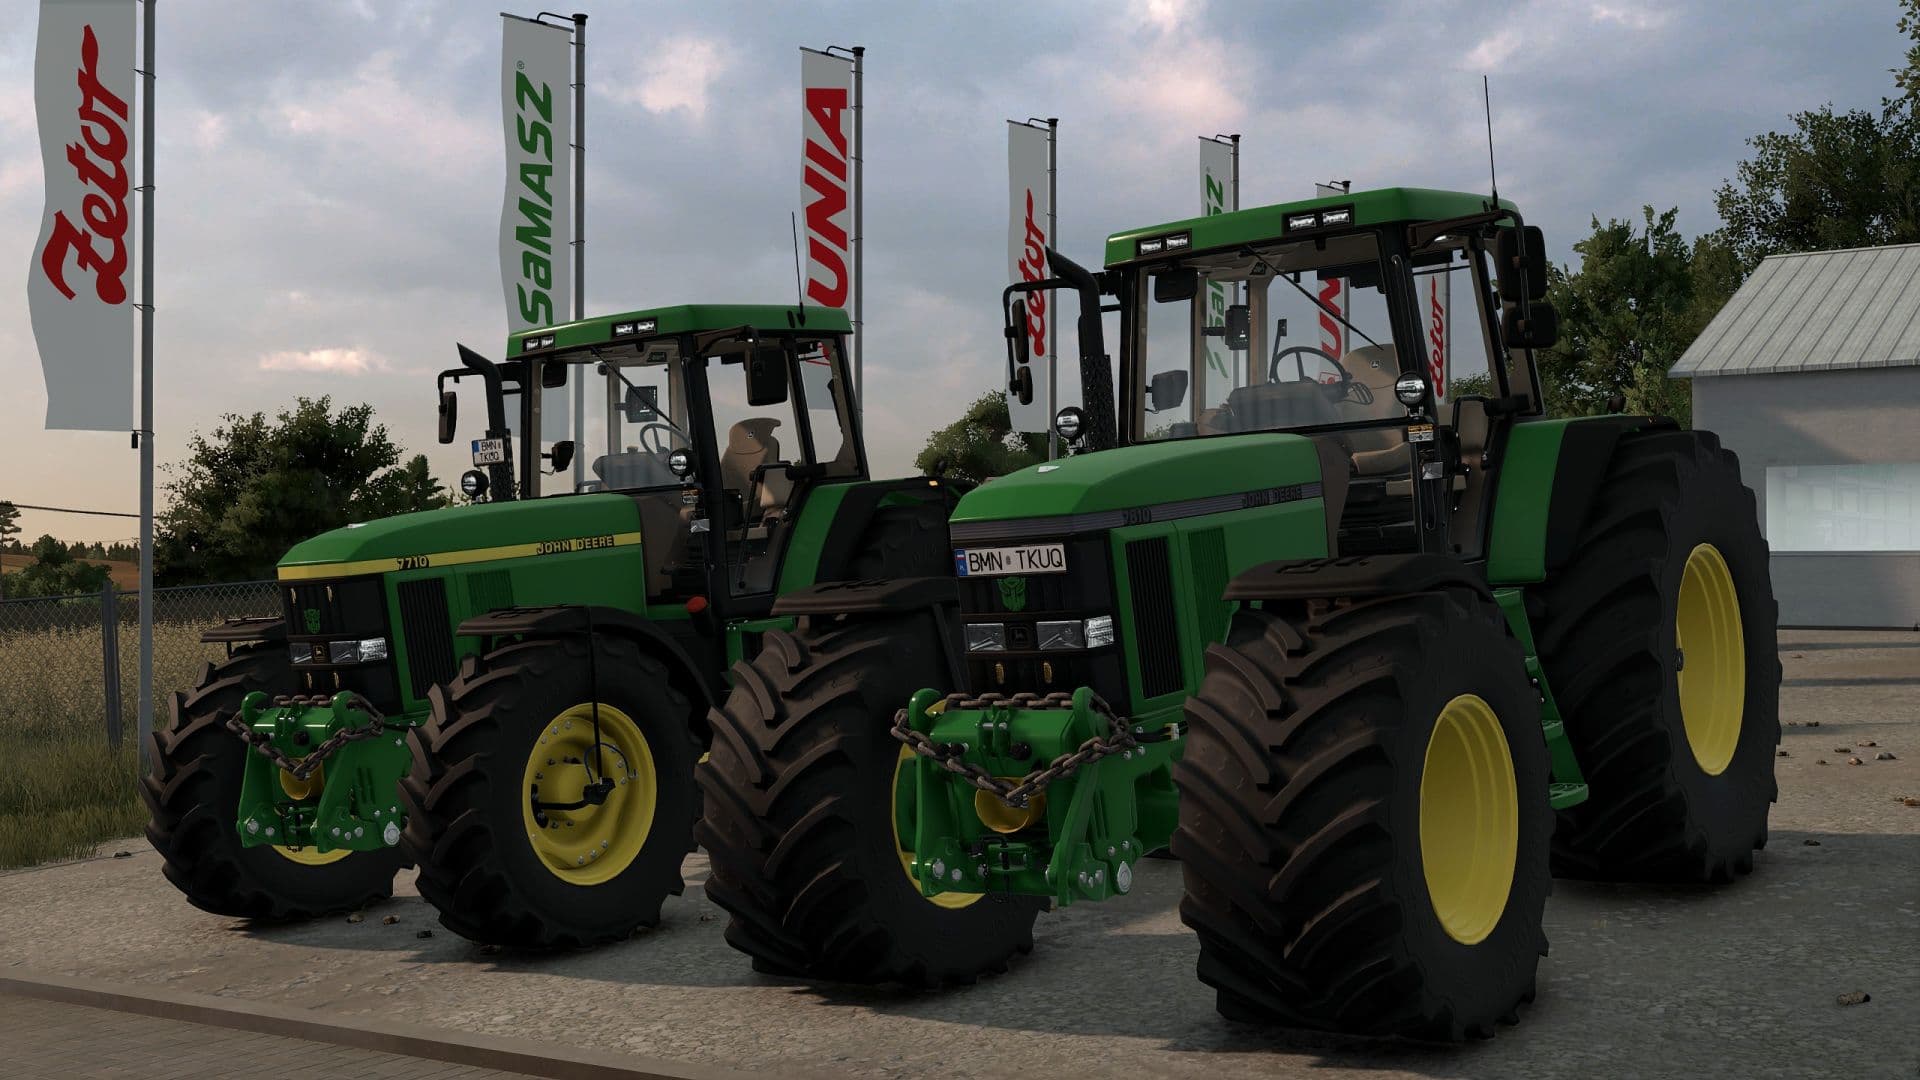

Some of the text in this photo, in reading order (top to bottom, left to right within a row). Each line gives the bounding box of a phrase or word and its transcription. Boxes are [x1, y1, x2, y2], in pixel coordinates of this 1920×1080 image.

[42, 25, 128, 304] Zetor
[804, 88, 848, 308] UNIA
[537, 535, 614, 555] JOHN DEERE
[397, 556, 429, 570] 7710
[968, 548, 1064, 572] BMN TKUQ
